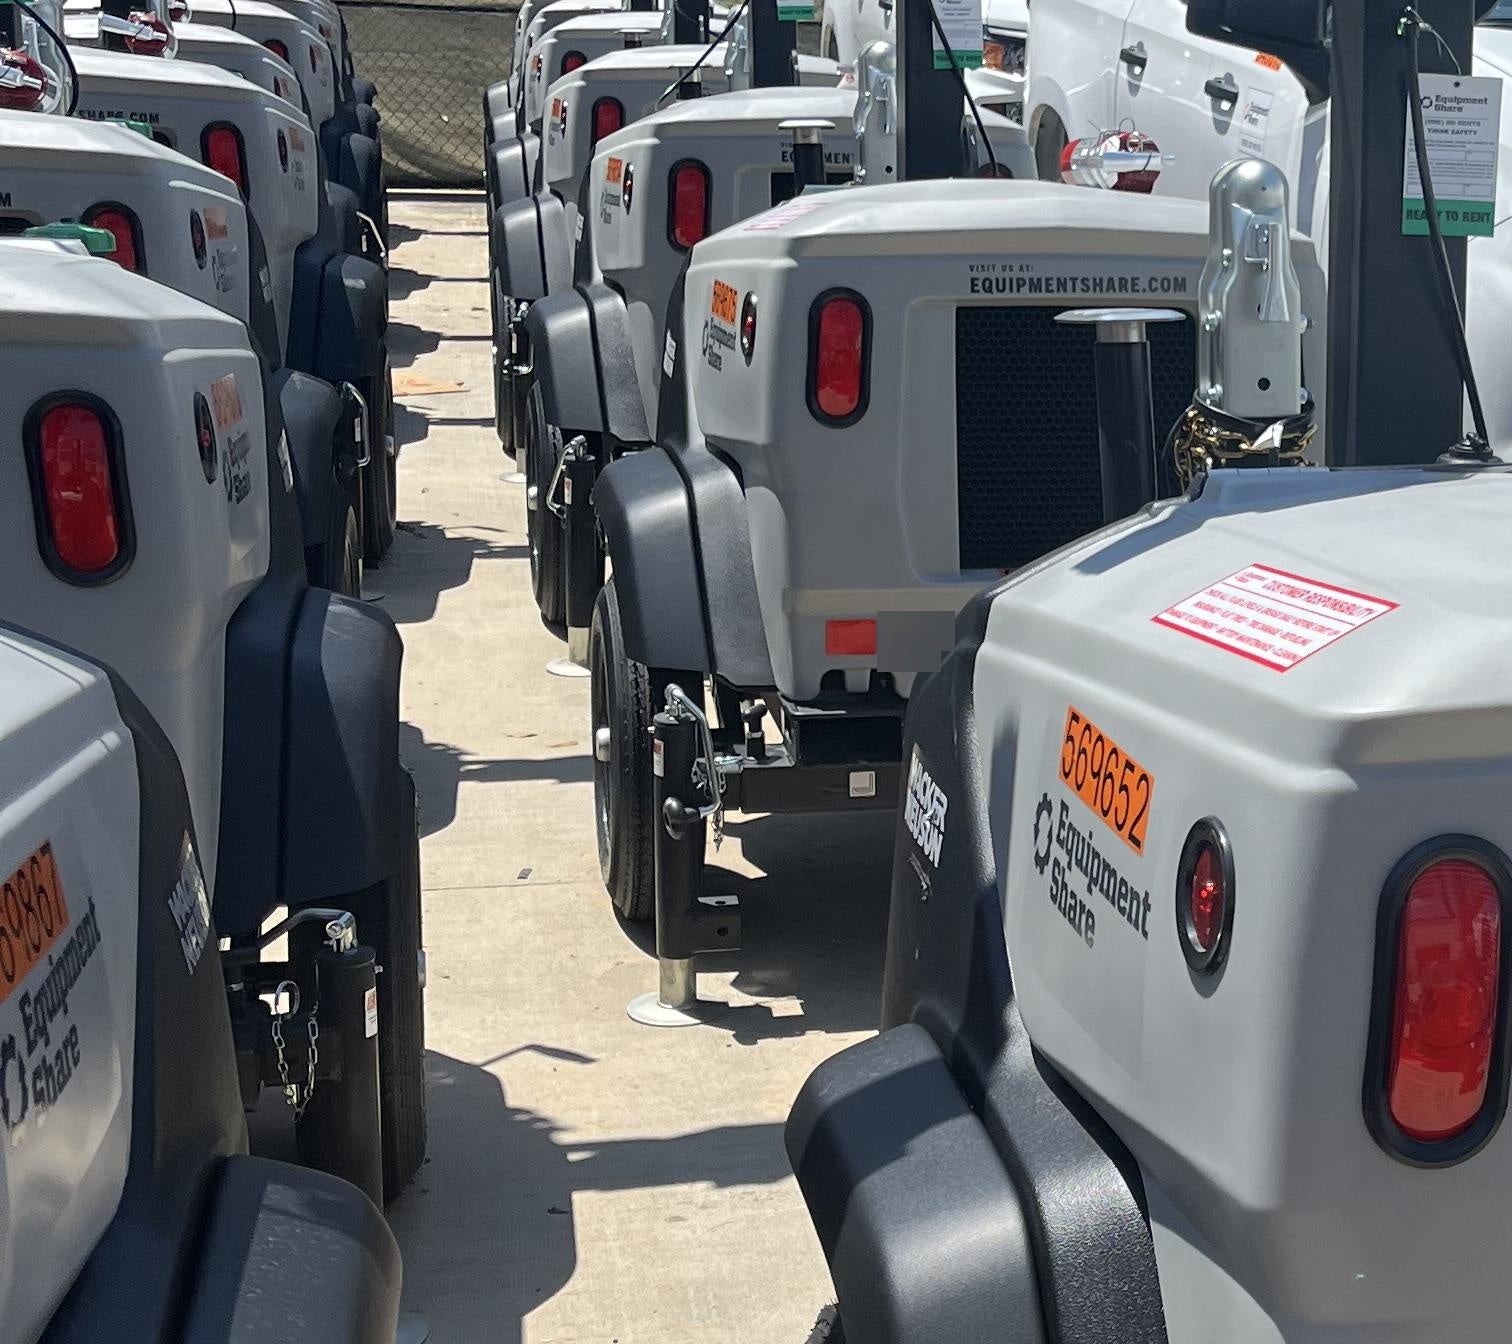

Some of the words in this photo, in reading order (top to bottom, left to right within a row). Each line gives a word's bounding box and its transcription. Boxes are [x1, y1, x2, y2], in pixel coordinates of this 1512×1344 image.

[1434, 95, 1488, 105] Equipment
[1434, 104, 1464, 113] Share
[1445, 210, 1459, 222] TO
[1462, 211, 1491, 223] RENT
[969, 264, 996, 273] VISIT
[1001, 264, 1014, 272] US
[969, 276, 1187, 295] EQUIPMENTSHARE.COM
[1062, 712, 1150, 849] 569652
[1056, 799, 1151, 940] Equipment
[1050, 857, 1096, 948] Share
[19, 896, 101, 1057] Equipment
[31, 1024, 81, 1106] Share
